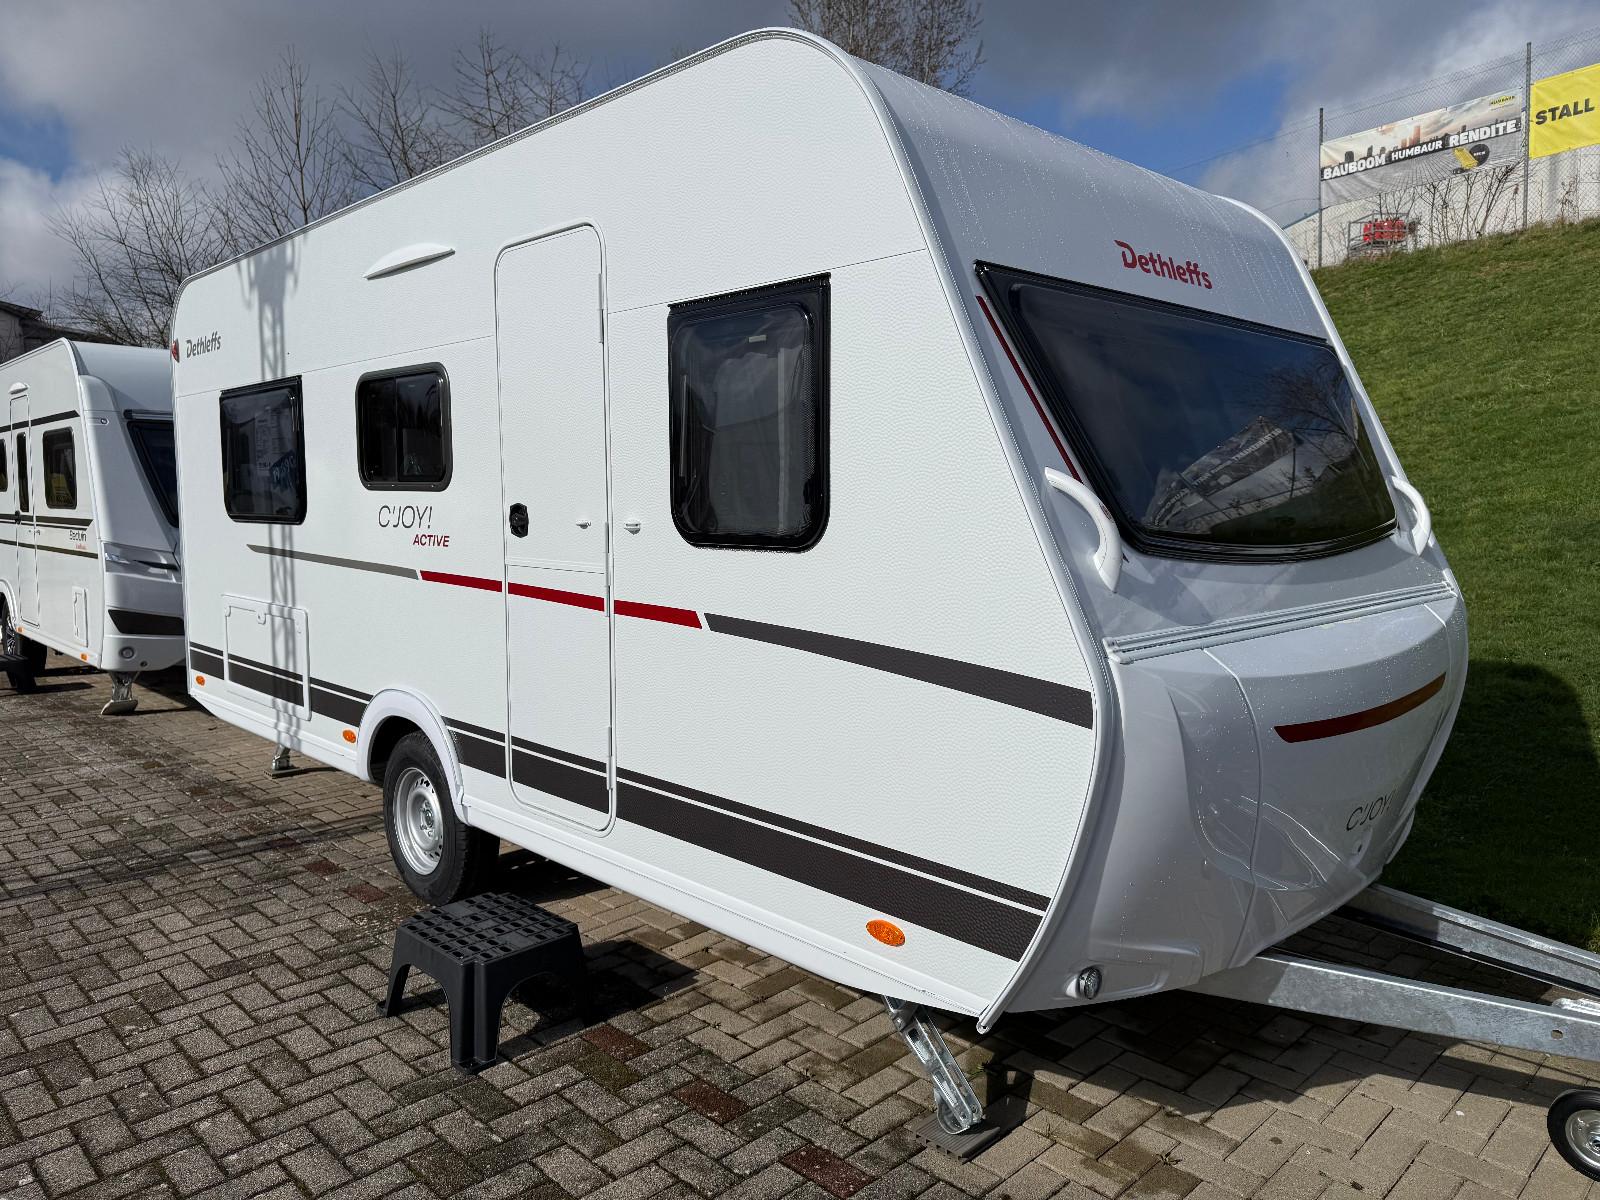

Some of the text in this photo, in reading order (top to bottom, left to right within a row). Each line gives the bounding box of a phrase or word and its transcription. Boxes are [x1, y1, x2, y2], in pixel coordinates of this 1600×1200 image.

[1535, 98, 1595, 125] STALL
[1323, 119, 1517, 180] BAUBOOM HUMBAUR RENDITE
[1114, 239, 1213, 290] Dethleffs
[185, 331, 222, 359] Dethleffs
[378, 504, 433, 529] C'JOY!
[413, 534, 450, 547] ACTIVE
